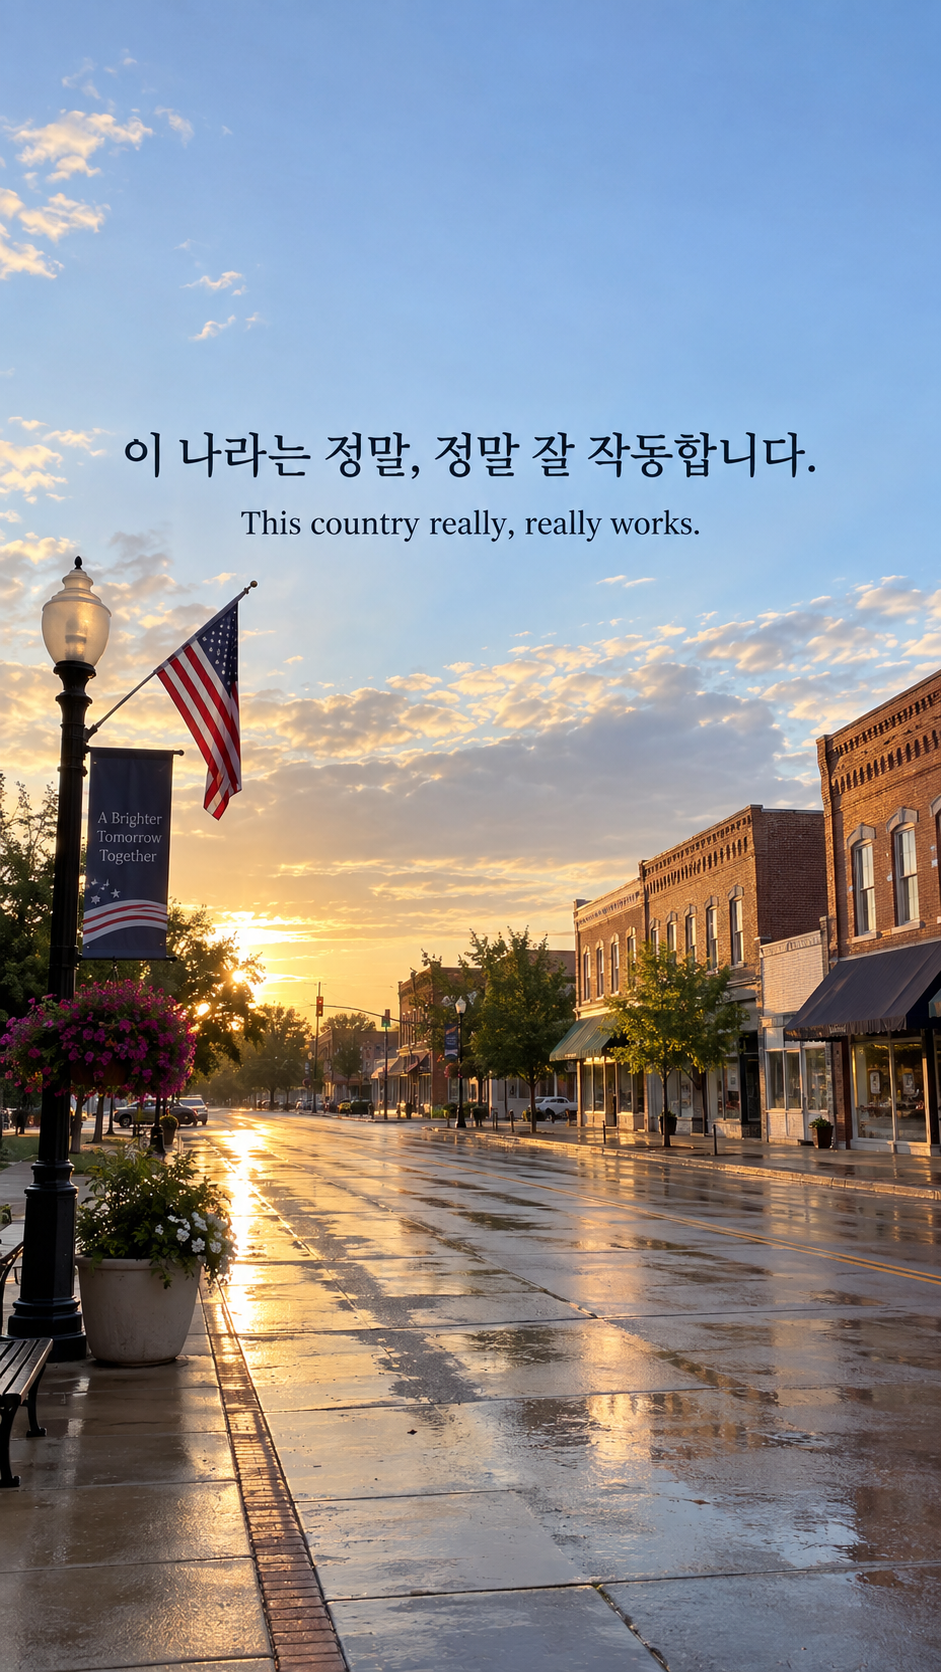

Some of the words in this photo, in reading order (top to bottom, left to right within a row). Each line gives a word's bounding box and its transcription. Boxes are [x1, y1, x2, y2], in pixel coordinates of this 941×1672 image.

[97, 811, 108, 824] A
[111, 811, 163, 828] Brighter
[96, 830, 162, 843] Tomorrow
[99, 849, 157, 865] Together
